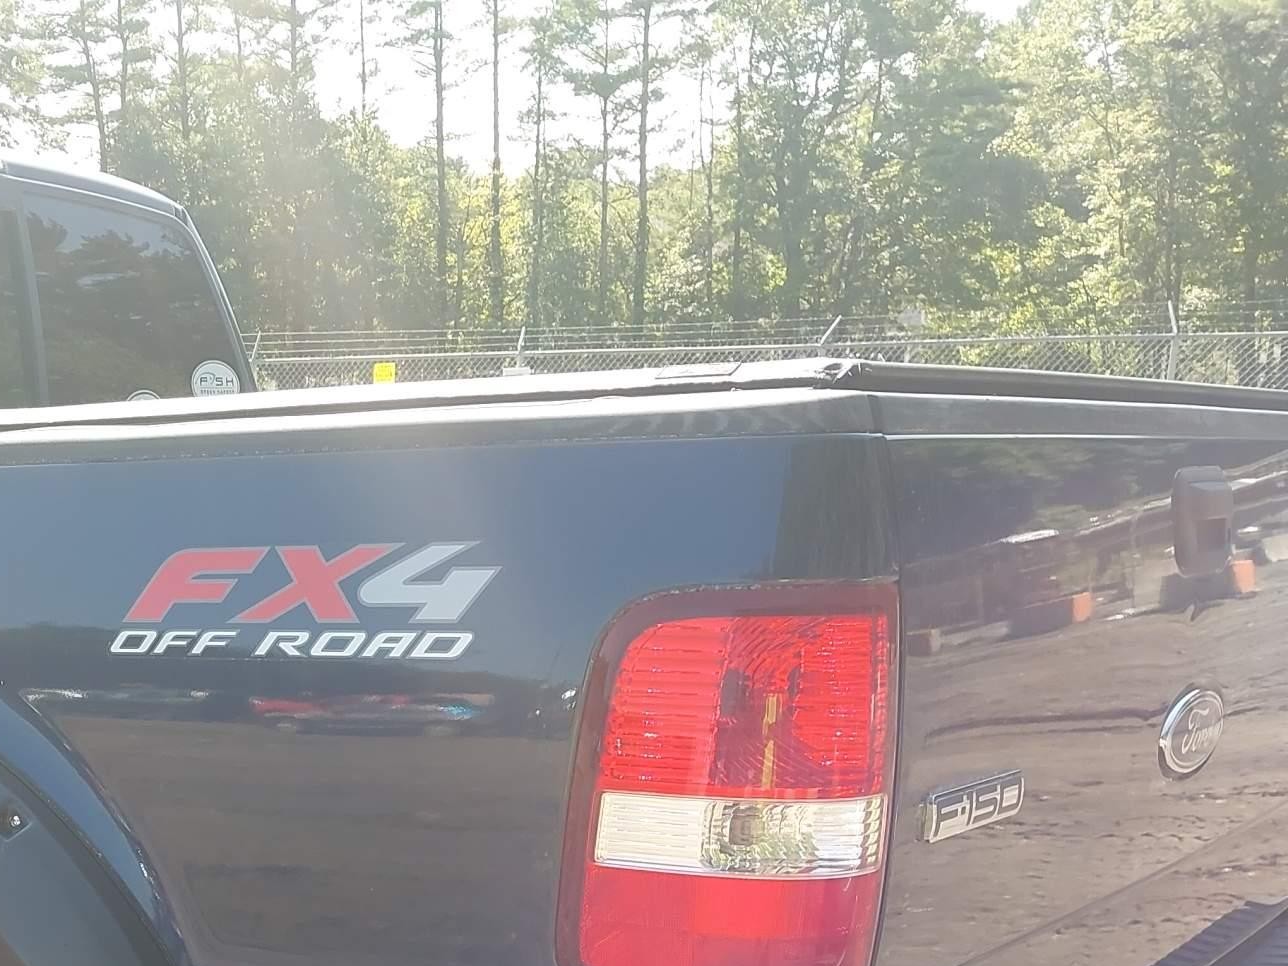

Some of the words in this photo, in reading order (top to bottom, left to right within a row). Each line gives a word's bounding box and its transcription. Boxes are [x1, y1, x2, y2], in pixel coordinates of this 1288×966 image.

[122, 541, 503, 623] FX4
[109, 629, 239, 656] OFF
[251, 630, 474, 660] ROAD
